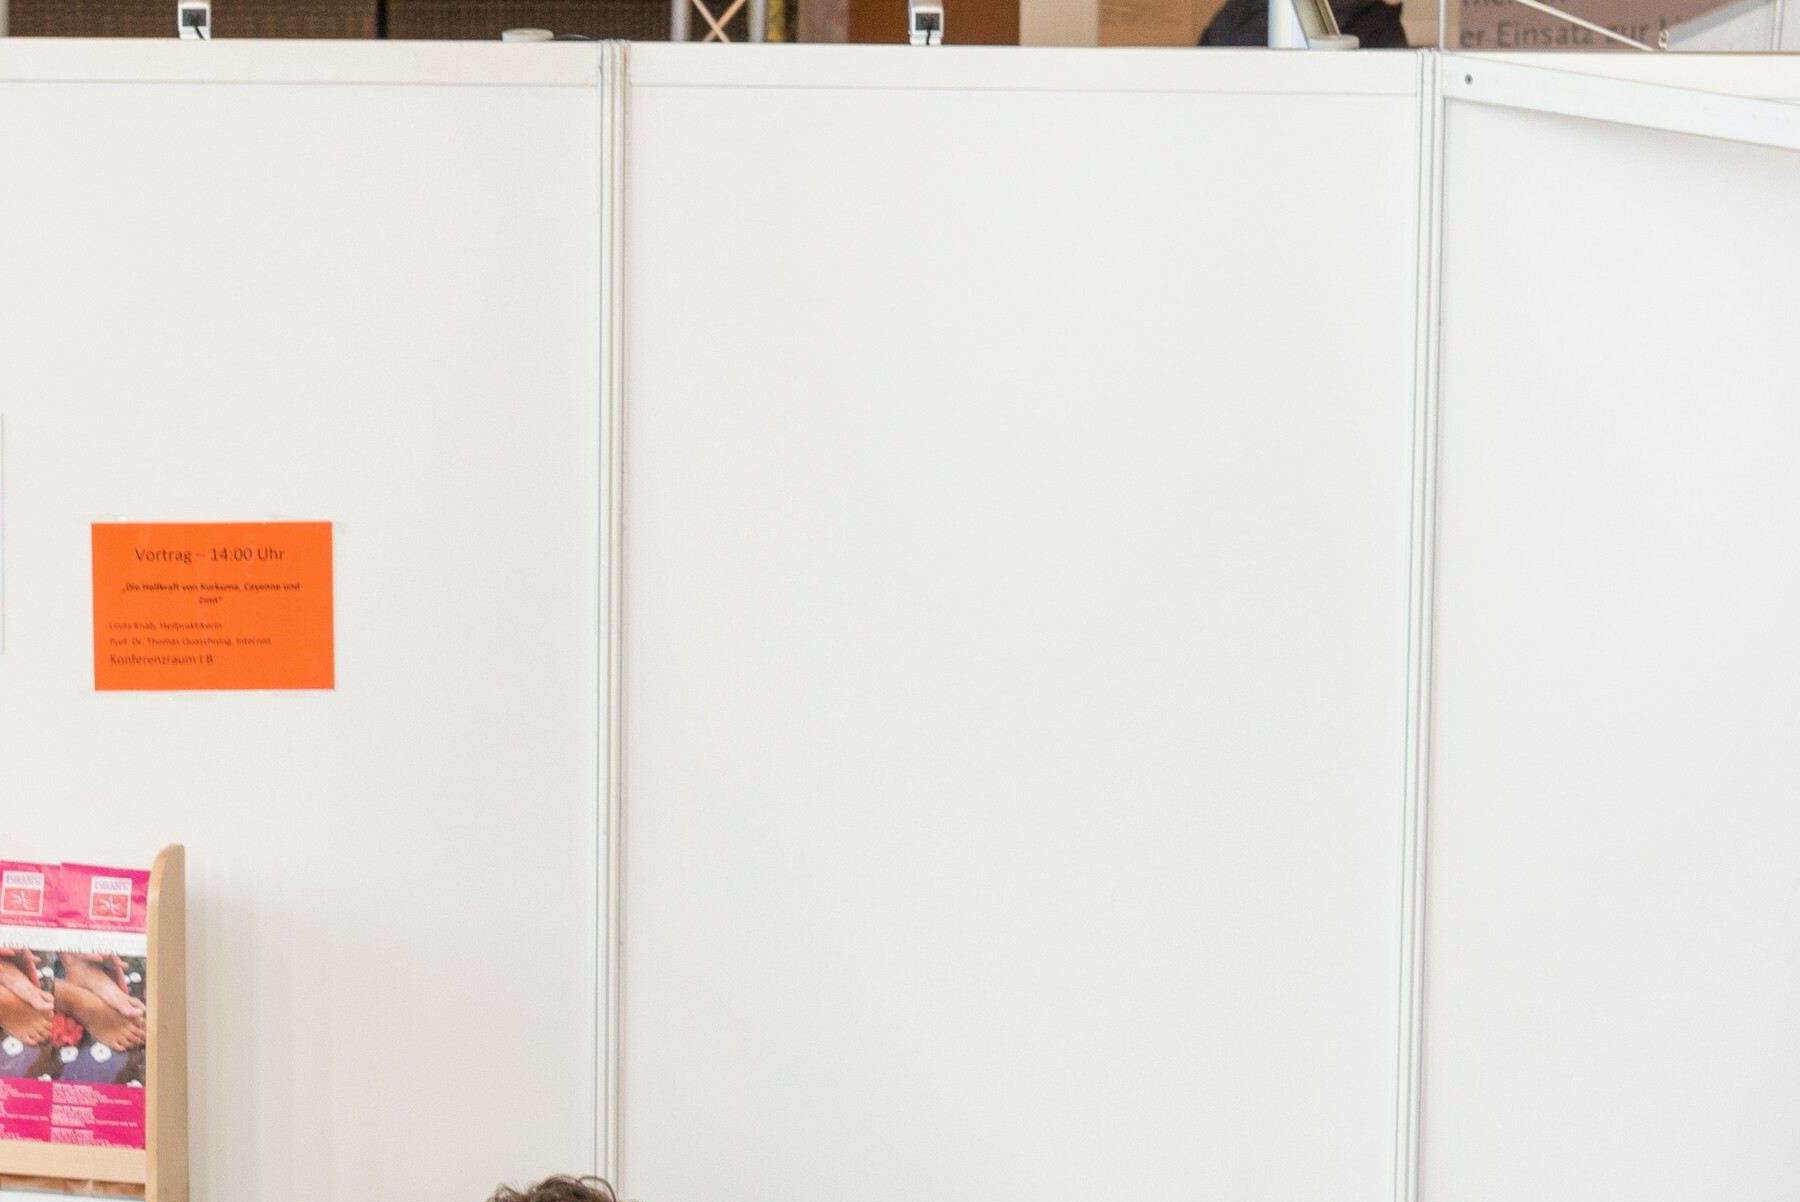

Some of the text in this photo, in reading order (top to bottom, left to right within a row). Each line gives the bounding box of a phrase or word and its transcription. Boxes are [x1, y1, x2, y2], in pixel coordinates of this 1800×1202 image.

[1497, 22, 1596, 49] Einsatz
[135, 548, 193, 564] Vortrag
[211, 548, 253, 561] 14:00
[258, 547, 285, 561] Uhr
[142, 583, 180, 591] Heilkraft
[244, 583, 281, 593] Cayenne
[283, 583, 300, 591] und
[110, 654, 197, 665] Konferenzraum
